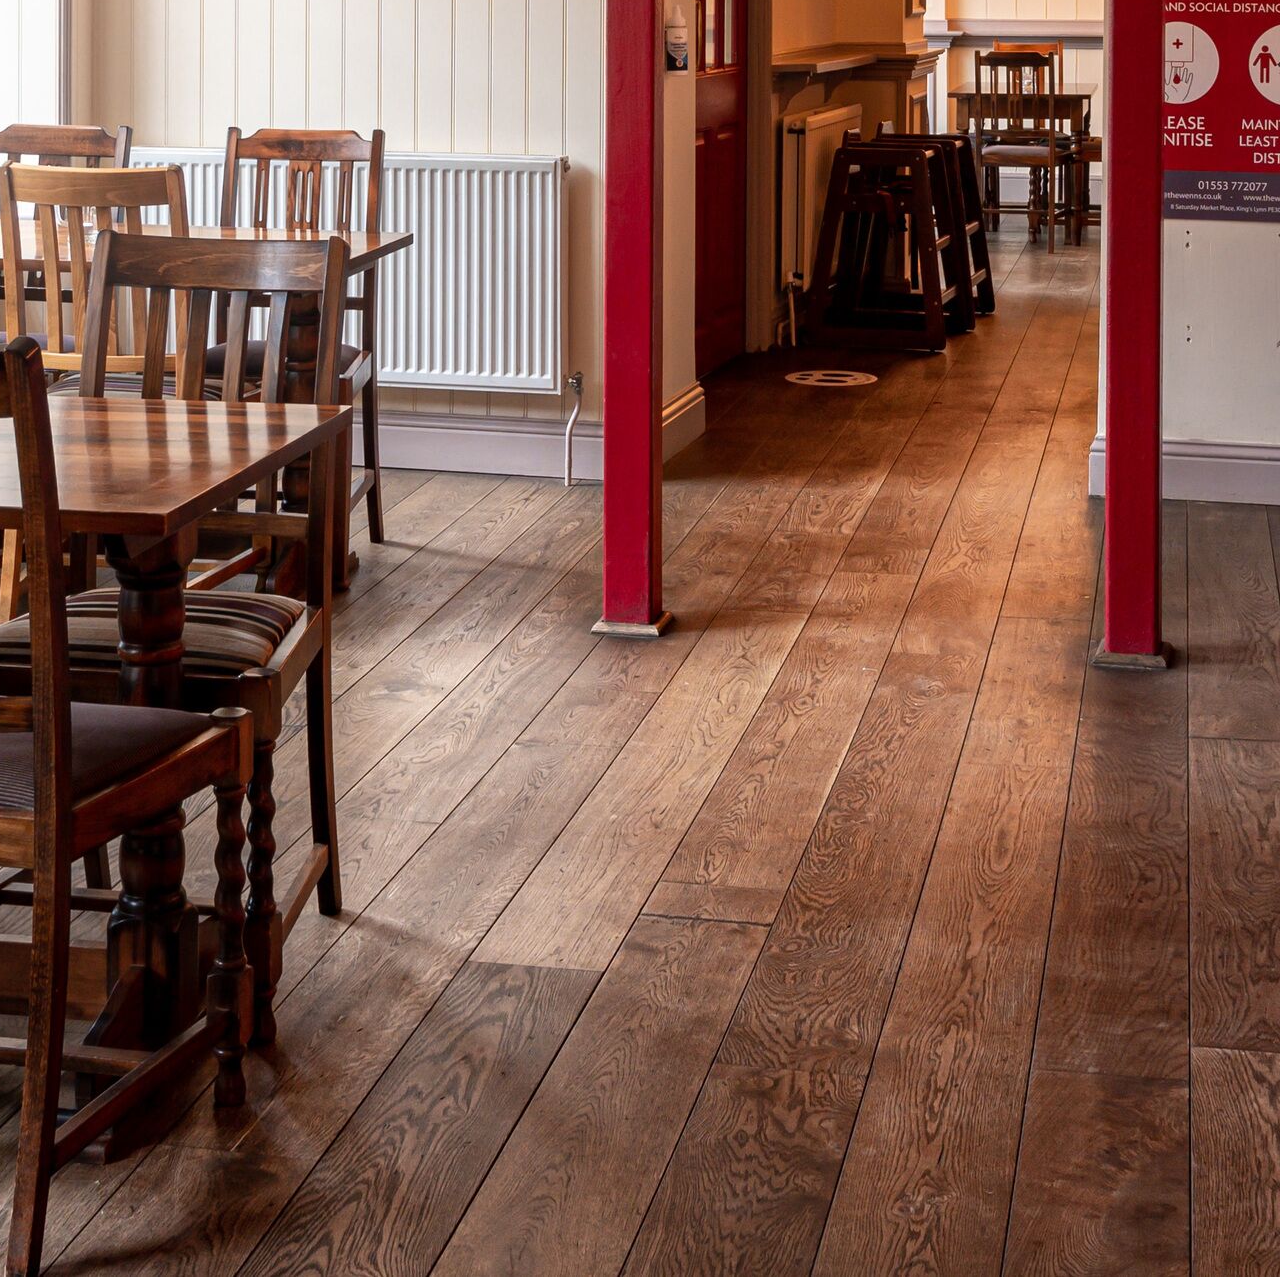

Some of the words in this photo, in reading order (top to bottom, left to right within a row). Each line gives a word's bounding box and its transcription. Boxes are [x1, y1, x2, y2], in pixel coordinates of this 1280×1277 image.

[1189, 2, 1230, 13] SOCIAL
[1164, 116, 1205, 130] EASE
[1163, 132, 1214, 147] NITISE
[1239, 135, 1279, 148] LEAST
[1198, 180, 1228, 191] 01553
[1231, 181, 1268, 191] 772077
[1175, 204, 1199, 212] Saturday
[1253, 206, 1267, 214] Lynn
